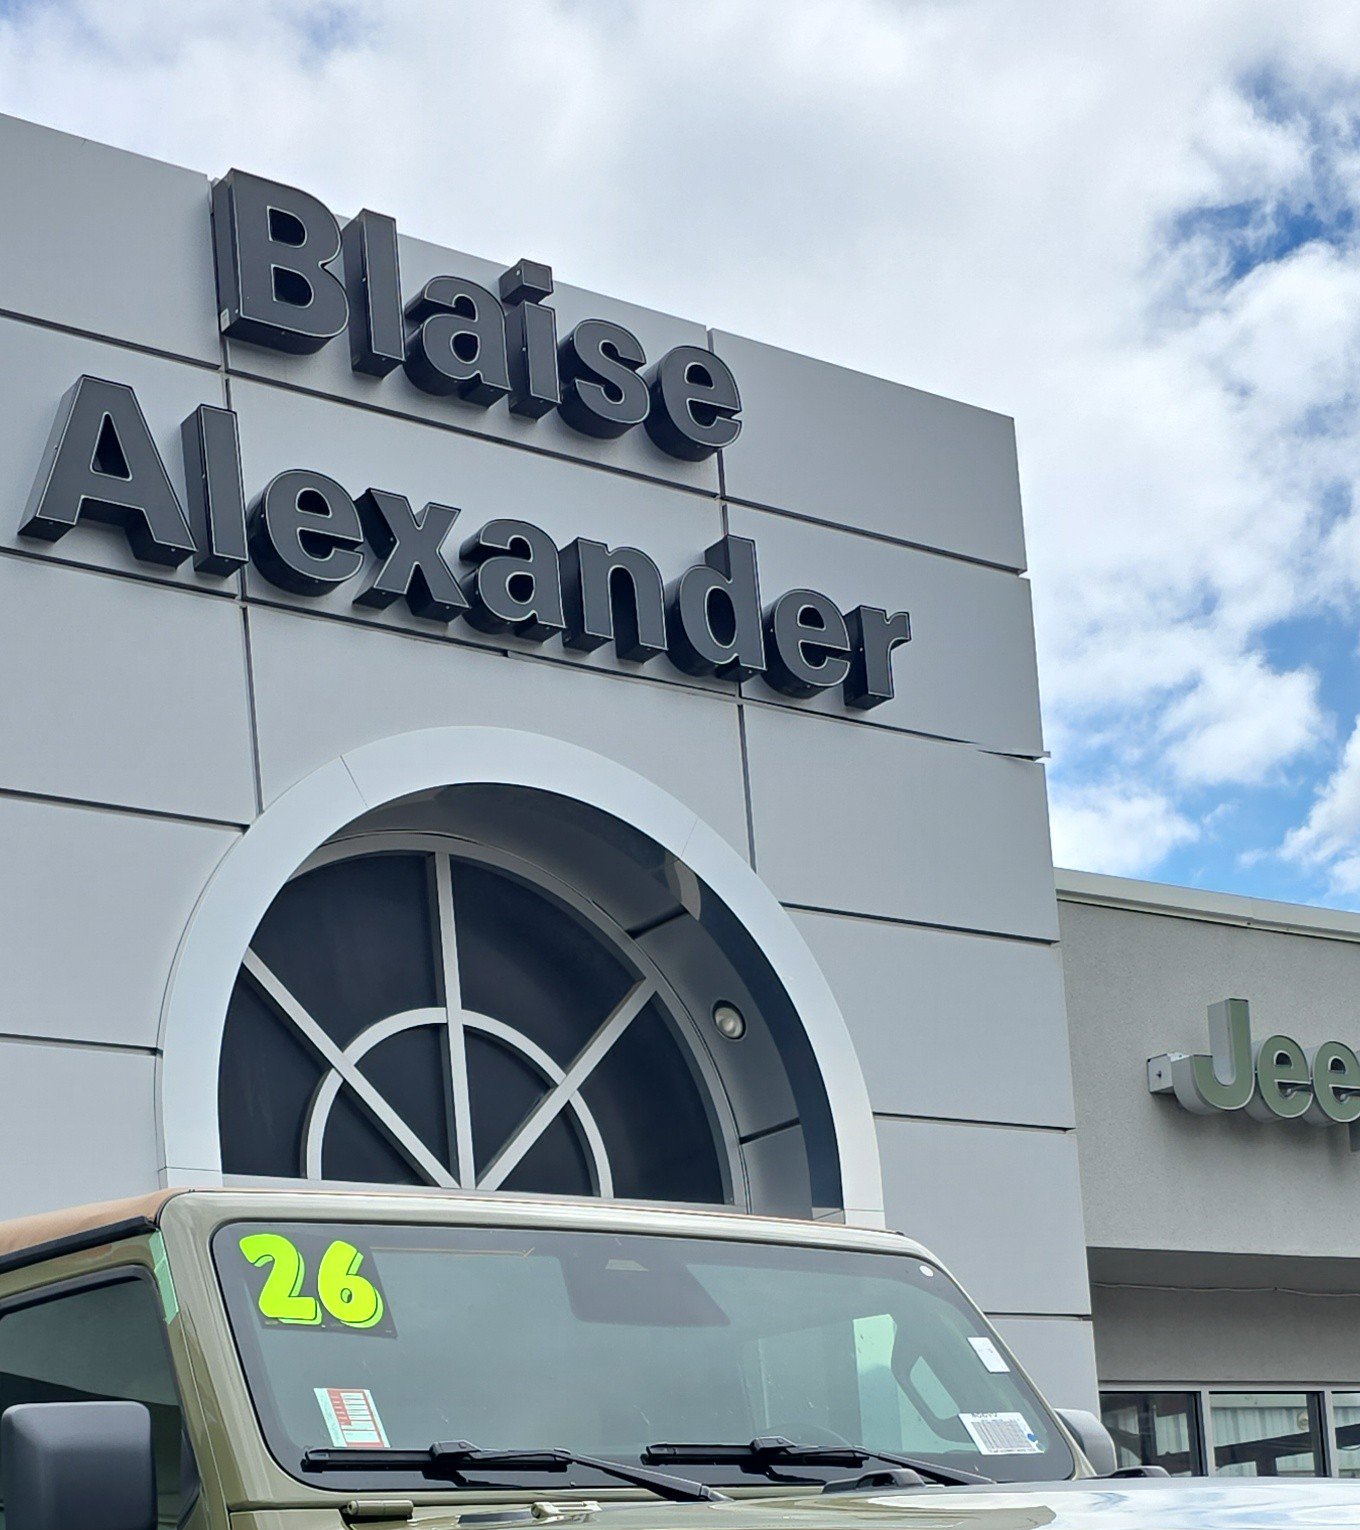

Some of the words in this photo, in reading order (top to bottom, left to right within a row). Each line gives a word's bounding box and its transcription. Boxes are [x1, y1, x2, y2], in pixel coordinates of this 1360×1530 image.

[212, 168, 742, 462] Blaise
[18, 375, 911, 710] Alexander
[239, 1233, 383, 1328] 26
